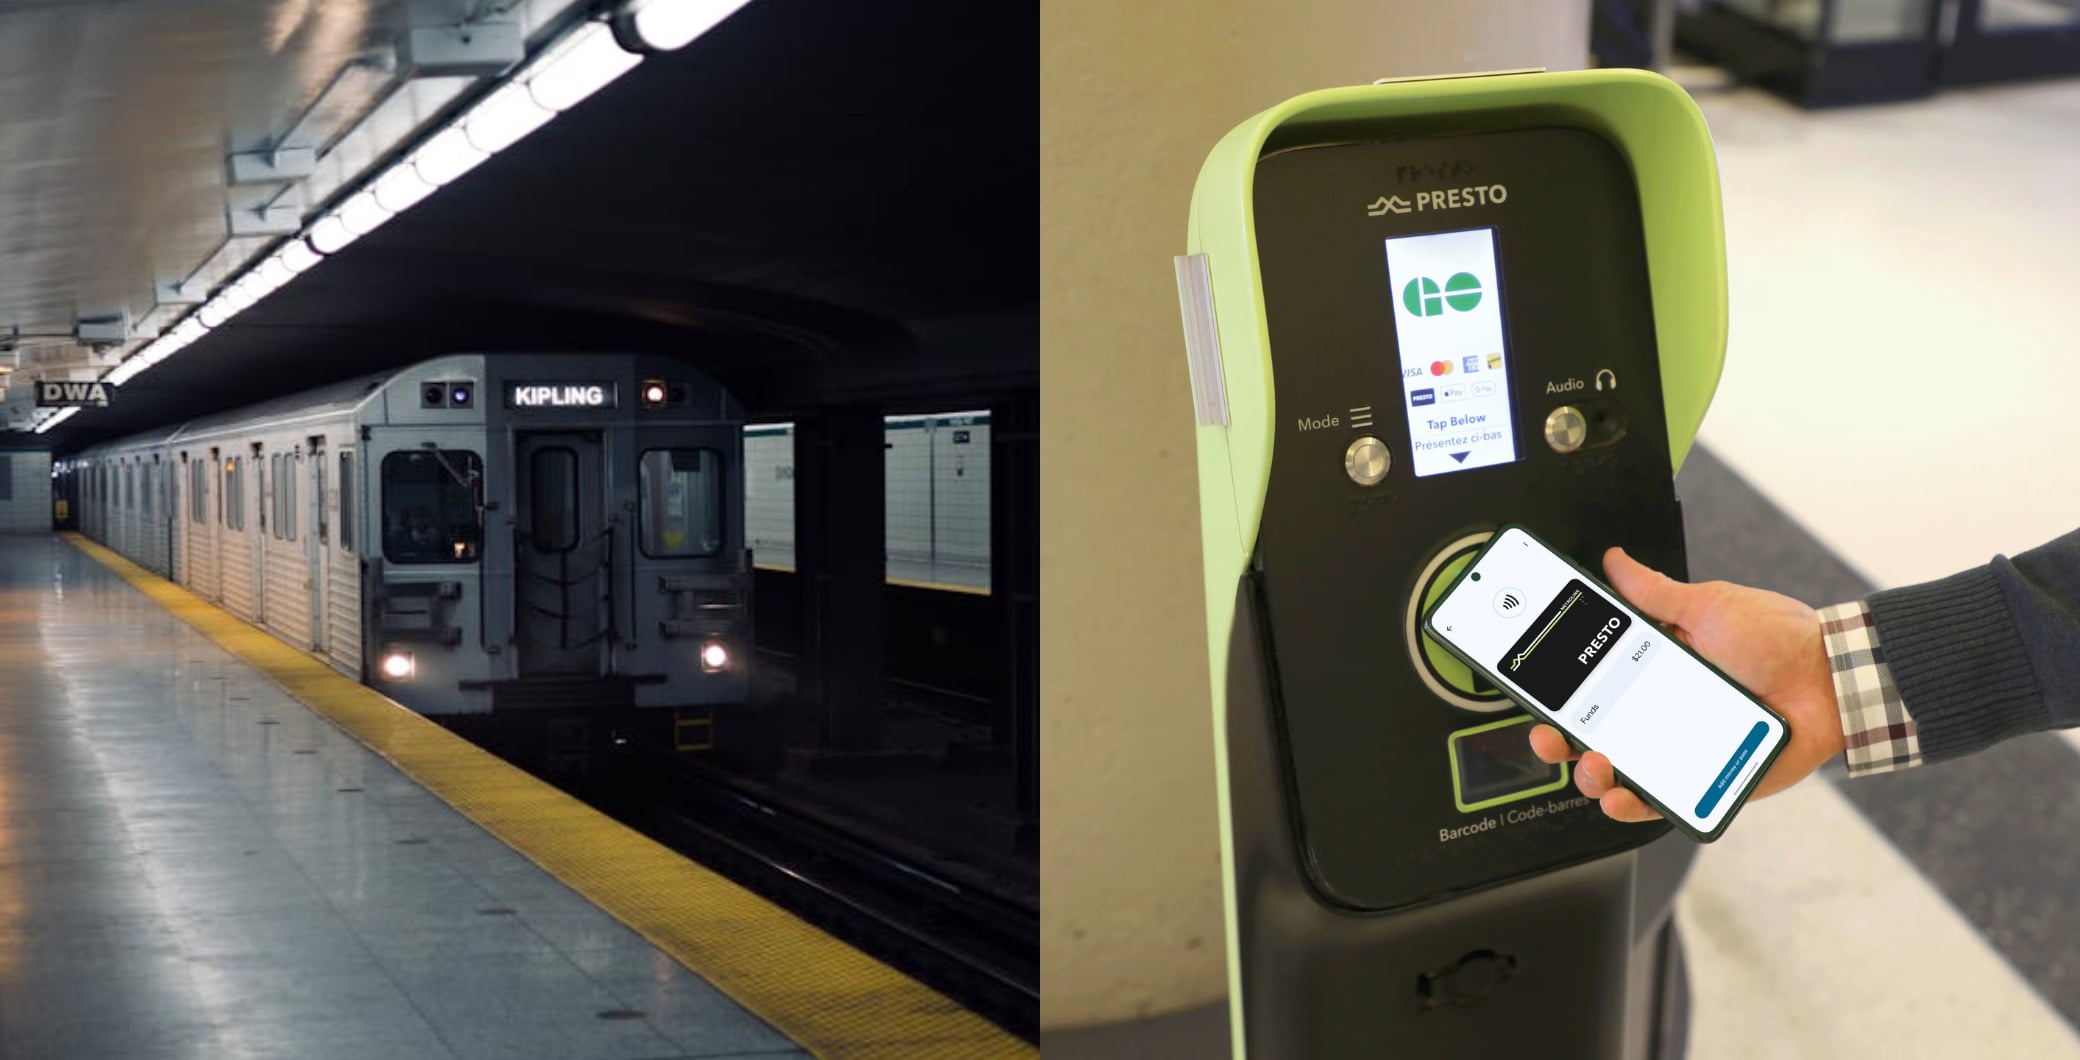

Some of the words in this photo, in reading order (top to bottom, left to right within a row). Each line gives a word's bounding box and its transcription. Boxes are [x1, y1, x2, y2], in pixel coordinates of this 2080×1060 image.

[1416, 184, 1508, 212] PRESTO
[1403, 272, 1483, 317] GO
[1402, 367, 1423, 378] VISA
[43, 383, 109, 401] DWA
[515, 386, 604, 406] KIPLING
[1546, 378, 1585, 395] Audio
[1412, 393, 1434, 403] PRESTO
[1298, 414, 1340, 432] Mode
[1427, 420, 1447, 431] Tap
[1450, 414, 1486, 427] Below
[1470, 431, 1502, 443] ci-bas
[1577, 617, 1621, 665] PRESTO
[1631, 640, 1651, 662] $21.00
[1580, 704, 1600, 725] Funds
[1439, 817, 1497, 842] Barcode
[1506, 798, 1590, 824] Code-barres
